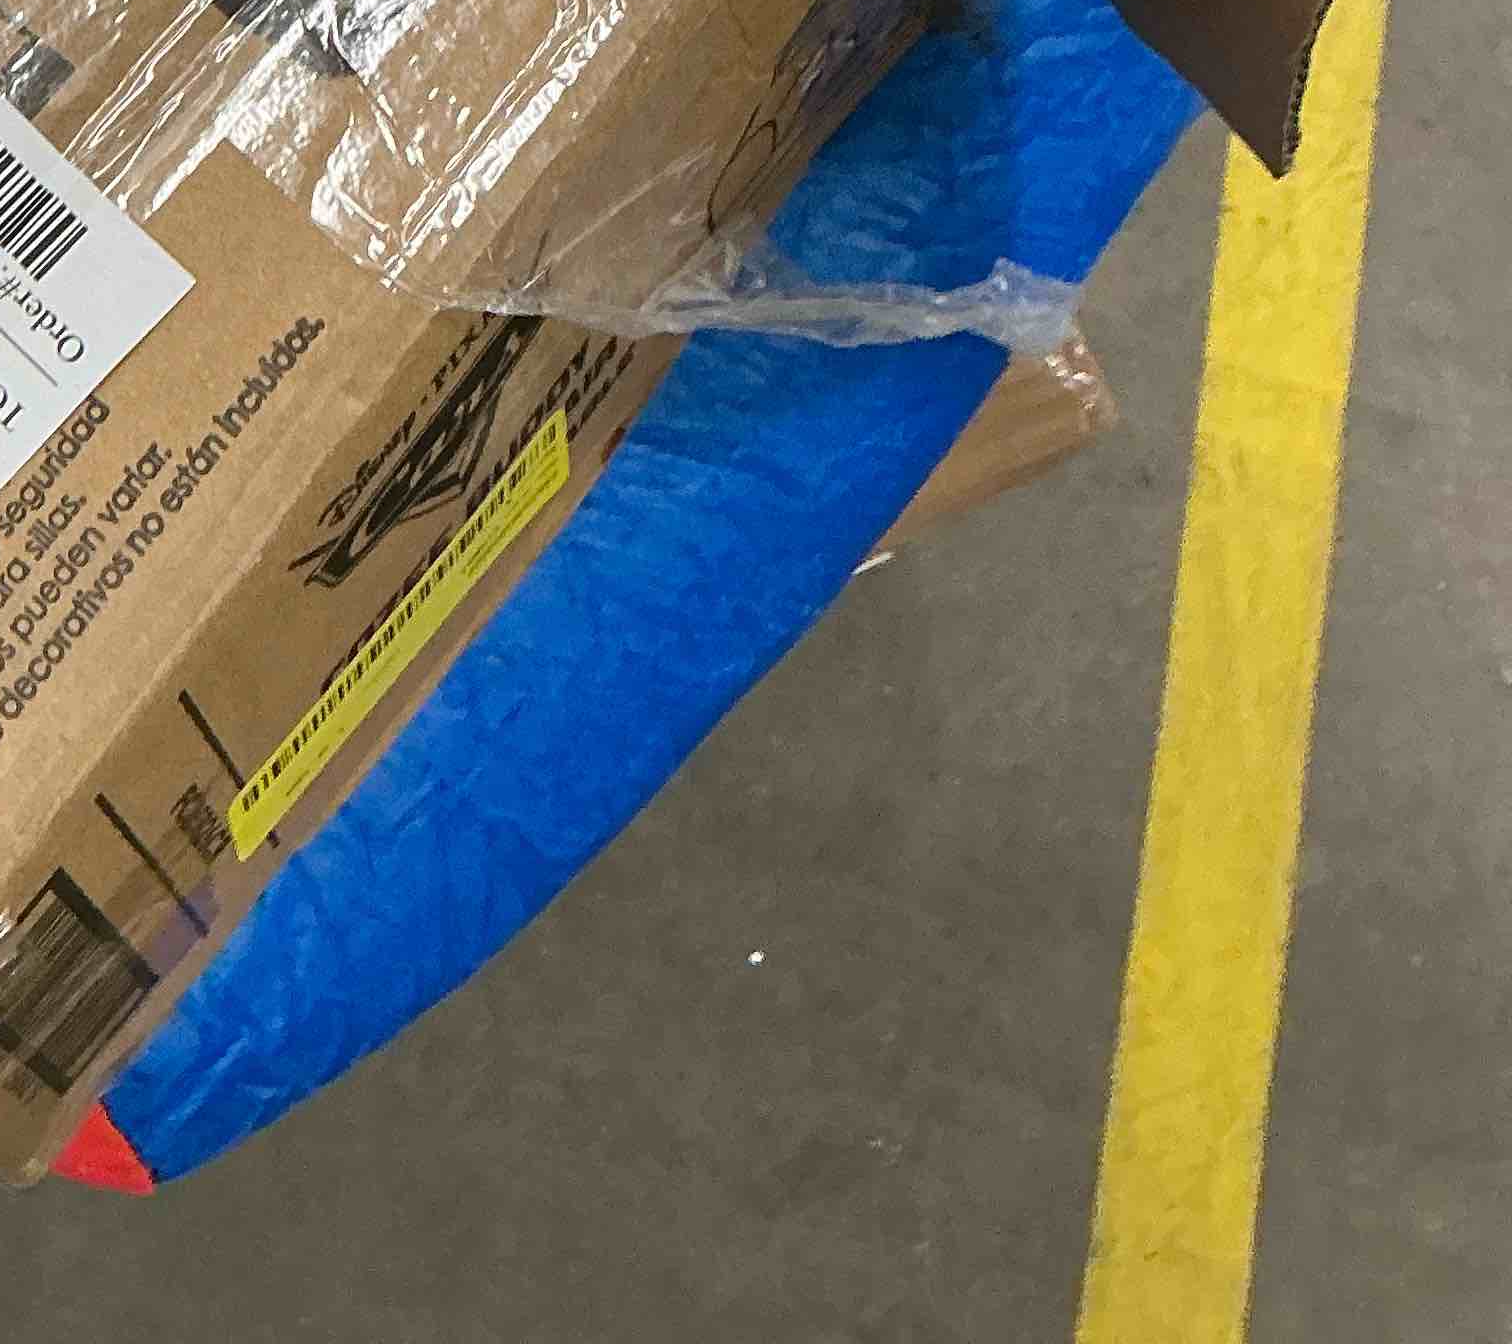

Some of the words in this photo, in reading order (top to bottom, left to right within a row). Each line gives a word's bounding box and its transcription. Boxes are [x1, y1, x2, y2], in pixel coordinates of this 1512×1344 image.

[9, 526, 106, 646] pueden
[96, 441, 173, 525] variar.
[24, 493, 88, 562] sillas.
[125, 511, 165, 558] no
[159, 431, 230, 513] están
